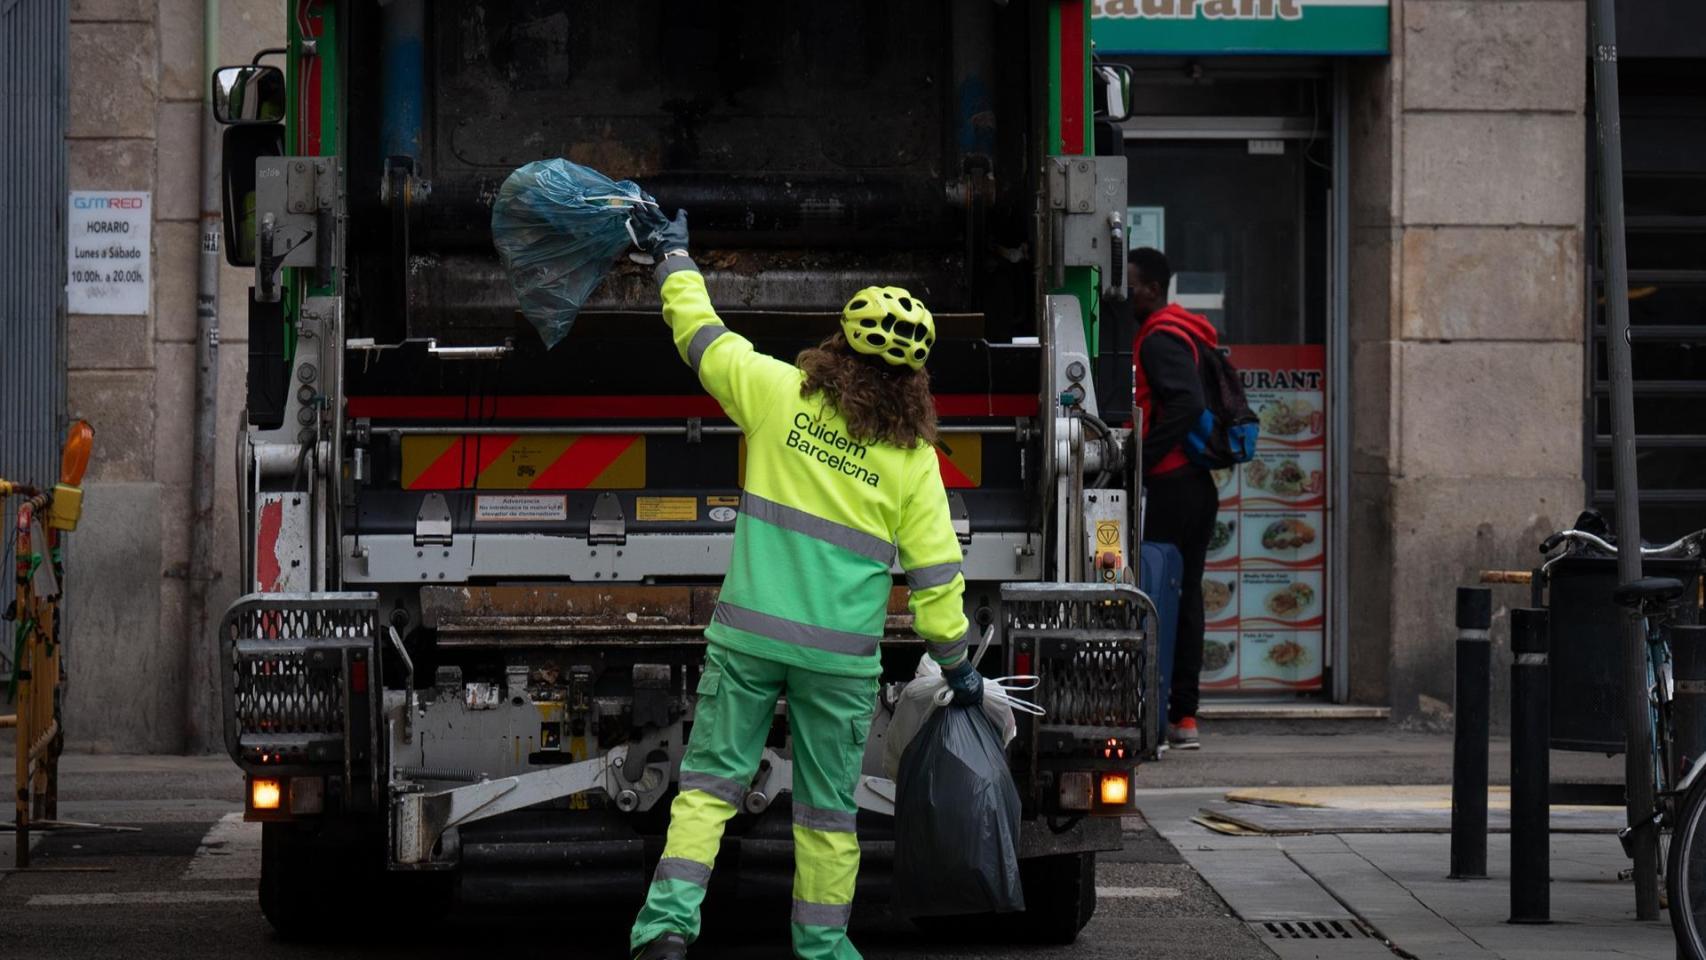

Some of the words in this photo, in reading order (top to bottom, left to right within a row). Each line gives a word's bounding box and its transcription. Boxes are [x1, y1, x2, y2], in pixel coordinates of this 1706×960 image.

[1091, 0, 1302, 19] aurant
[87, 221, 129, 234] HORARIO
[75, 247, 99, 259] Lunes
[101, 250, 107, 259] a
[72, 271, 103, 283] 10.00h.
[105, 274, 110, 282] a
[113, 271, 144, 284] 20.00h.
[1240, 371, 1321, 389] URANT
[794, 412, 867, 460] Cuidem
[786, 429, 880, 488] Barcelona
